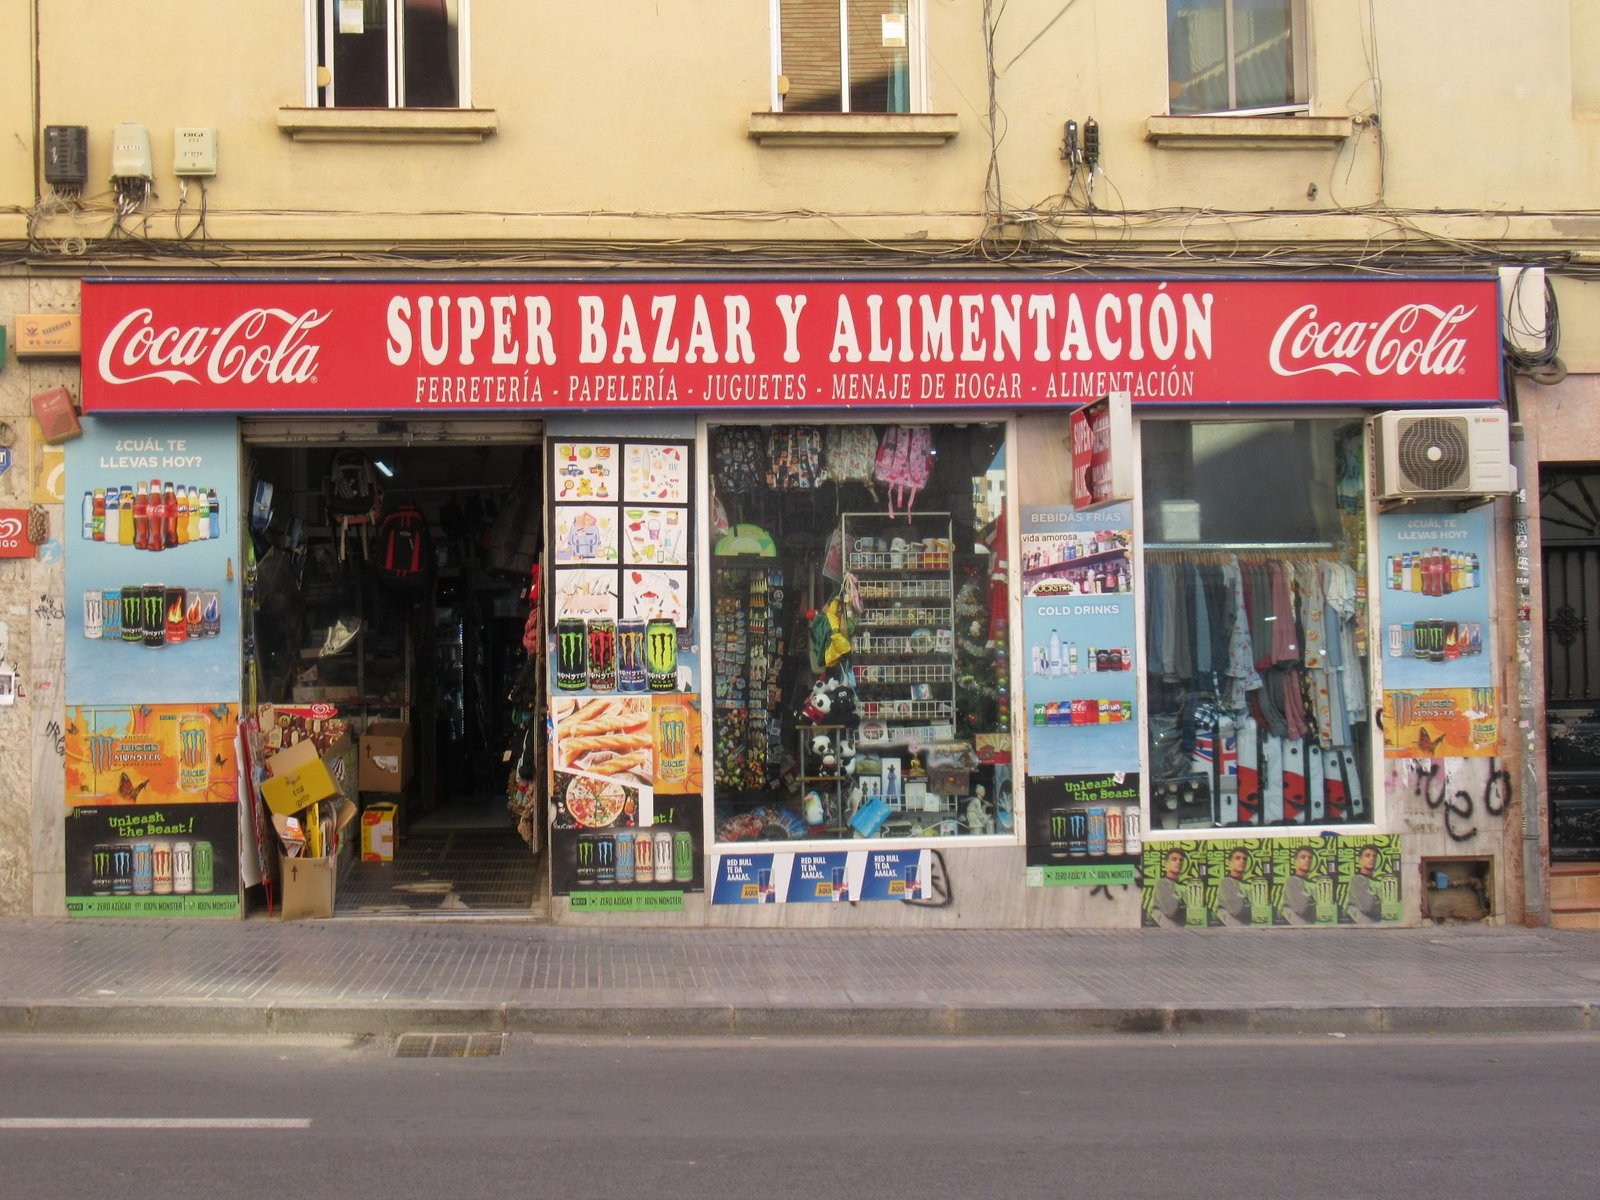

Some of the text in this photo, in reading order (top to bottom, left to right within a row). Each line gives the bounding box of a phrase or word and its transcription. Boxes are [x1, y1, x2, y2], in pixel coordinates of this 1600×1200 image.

[386, 281, 1214, 367] SUPER BAZAR Y ALIMENTACIÓN
[1269, 303, 1478, 377] Coca-Cola
[98, 308, 333, 385] Coca-Cola
[415, 369, 543, 404] FERRETERÍA
[568, 367, 678, 403] PAPELERÍA
[702, 373, 806, 402] JUGUETES
[831, 373, 911, 401] MENAJE
[920, 373, 945, 400] DE
[954, 372, 1022, 400] HOGAR
[1045, 365, 1194, 399] ALIMENTACIÓN
[115, 437, 187, 453] ¿CUÁL TE
[100, 456, 203, 468] LLEVAS HOY?
[1031, 511, 1122, 523] BEBIDAS FRÍAS
[1408, 518, 1456, 529] ¿CUÁL TE
[1022, 533, 1040, 542] vida
[1398, 532, 1468, 540] LLEVAS HOY?
[0, 540, 18, 548] IGO
[1038, 605, 1120, 616] COLD DRINKS
[117, 742, 160, 752] JUICED
[1064, 778, 1116, 792] Unleash
[1074, 788, 1136, 801] the Beast
[108, 812, 166, 828] Unleash
[118, 826, 144, 838] the
[1110, 871, 1133, 879] MONSTER
[112, 902, 131, 910] AZÚCAR
[159, 902, 182, 911] MONSTER
[614, 896, 632, 905] AZÚCAR
[659, 897, 681, 905] MONSTER
